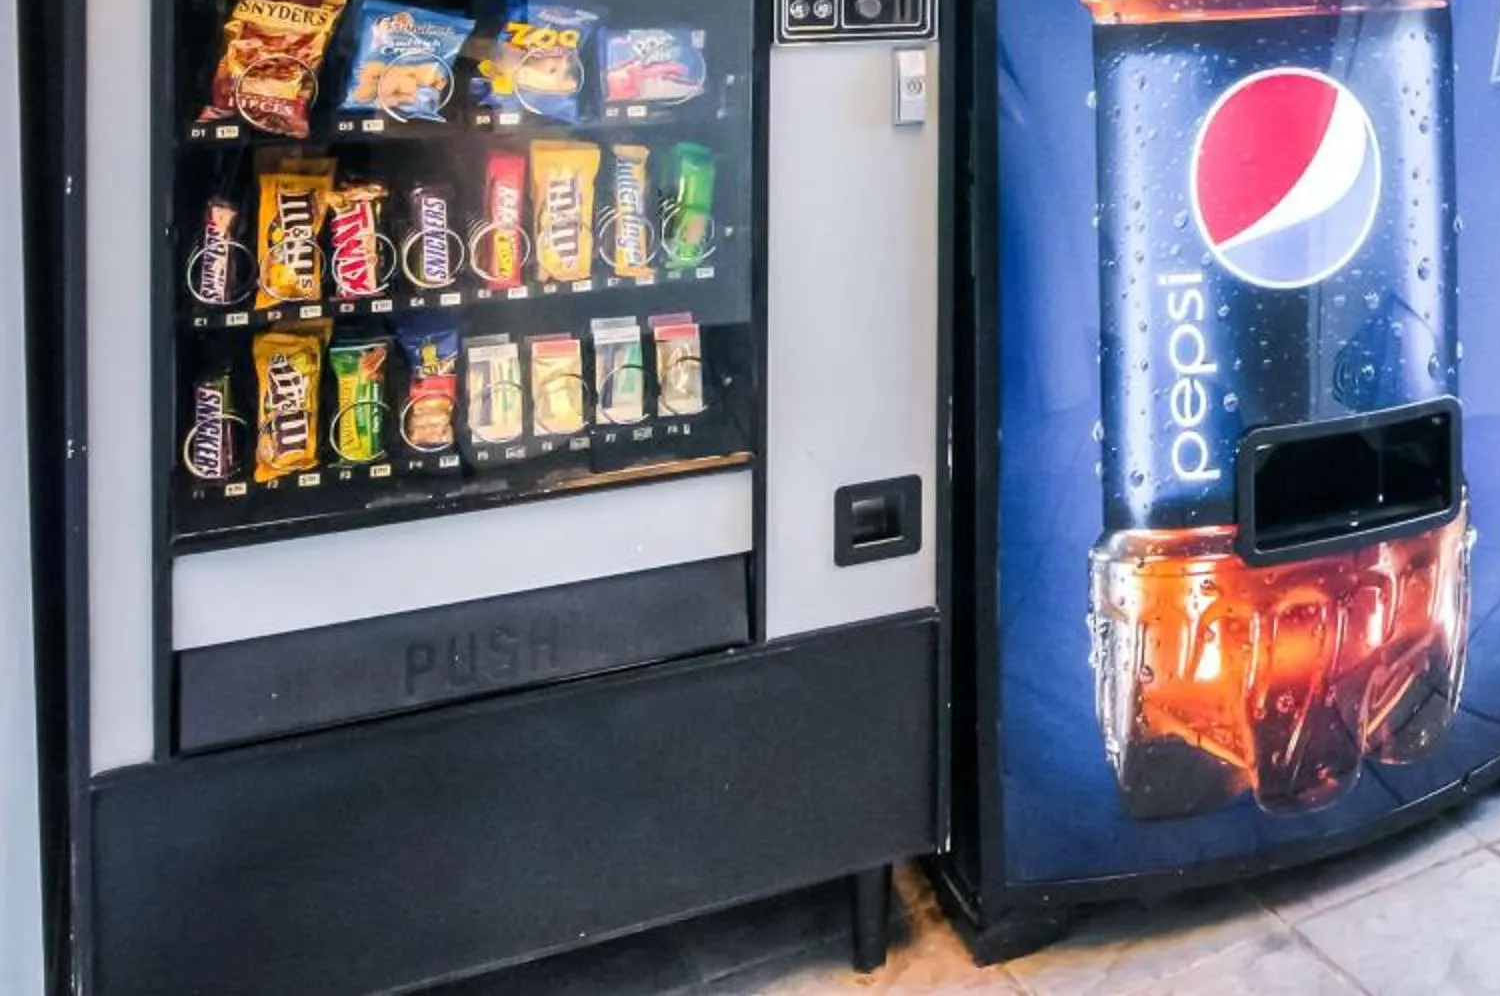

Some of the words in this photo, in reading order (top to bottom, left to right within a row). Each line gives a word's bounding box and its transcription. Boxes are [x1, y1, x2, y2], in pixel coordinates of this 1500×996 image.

[191, 128, 206, 138] D1
[422, 198, 448, 284] SNICKERS
[1157, 269, 1221, 482] pepsi
[197, 387, 221, 479] SNICKERS
[404, 616, 561, 697] PUSH
